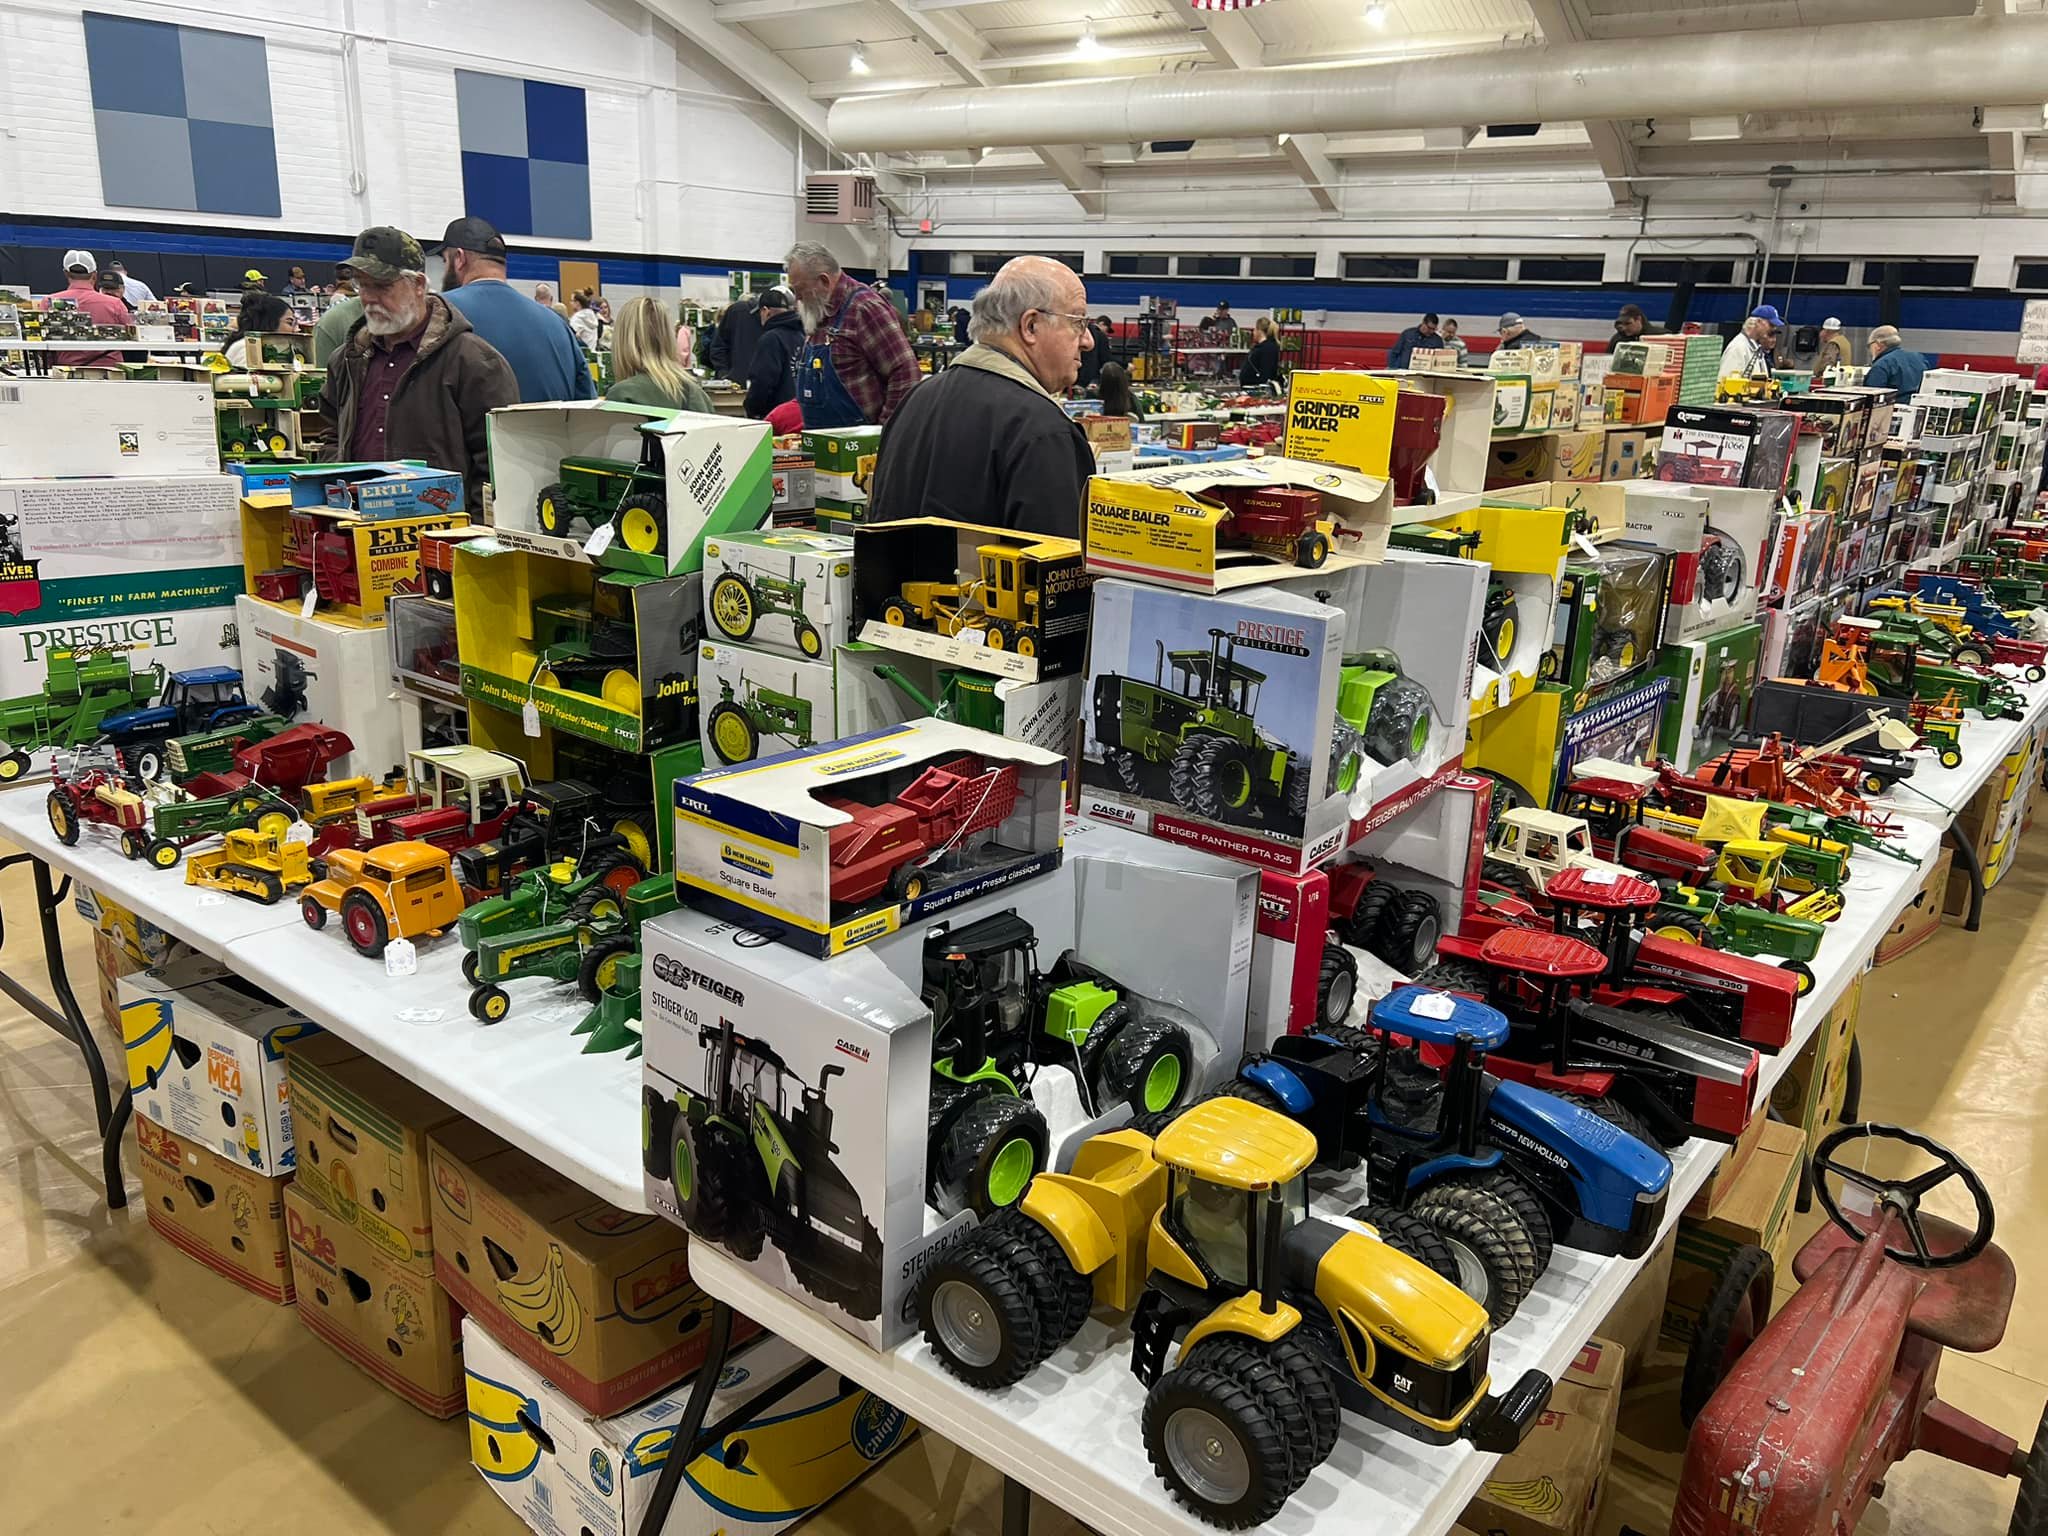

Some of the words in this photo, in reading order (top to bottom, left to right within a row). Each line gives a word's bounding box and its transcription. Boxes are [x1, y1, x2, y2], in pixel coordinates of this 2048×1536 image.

[1311, 388, 1342, 396] HOLLAND
[1294, 400, 1360, 419] GRINDER
[1292, 415, 1338, 432] MIXER
[1697, 432, 1745, 441] INTERNTIONAL
[1724, 441, 1745, 450] 1066
[845, 441, 859, 452] 435
[689, 469, 704, 493] JOHN
[703, 442, 722, 470] DEERE
[705, 455, 722, 481] MFWD
[361, 483, 412, 497] ERTL
[697, 467, 723, 505] TRACTOR
[1256, 499, 1282, 508] HOLLAND
[1090, 503, 1130, 520] SQUARE
[1132, 510, 1170, 527] BALER
[1625, 521, 1653, 531] RACTOR
[497, 533, 512, 541] JOHN
[513, 535, 532, 545] DEERE
[375, 544, 410, 555] MASSEY
[531, 545, 559, 556] TRACTOR
[0, 565, 33, 576] IVER
[371, 557, 409, 572] COMBINE
[815, 563, 824, 578] 2
[1046, 568, 1069, 583] JOHN
[1071, 566, 1087, 579] DEE
[1046, 579, 1075, 594] MOTOR
[111, 594, 123, 602] IN
[128, 592, 156, 600] FARM
[19, 617, 177, 662] PRESTIGE
[1238, 619, 1305, 648] PRESTIGE
[71, 643, 136, 660] Collection
[1236, 639, 1305, 656] COLLECTION
[656, 680, 688, 698] John
[480, 682, 500, 697] John
[501, 689, 526, 705] Deere
[532, 699, 555, 715] 420T
[555, 708, 609, 733] Tractor/Tracteur
[1022, 714, 1038, 737] JOHN
[1037, 692, 1058, 717] DEERE
[681, 796, 711, 813] ERTL
[1092, 803, 1124, 818] CASE
[1365, 806, 1398, 833] STEIGER
[1398, 783, 1434, 810] PANTHER
[1158, 823, 1199, 840] STEIGER
[1201, 834, 1249, 854] PANTHER
[1251, 847, 1271, 859] PTA
[1274, 852, 1293, 865] 325
[1309, 838, 1334, 860] CASE
[732, 849, 745, 860] NEW
[744, 852, 770, 869] HOLLAND
[719, 870, 751, 889] Square
[753, 883, 777, 899] Baler
[923, 895, 952, 912] Square
[954, 886, 975, 900] Baler
[982, 875, 1007, 890] Presse
[1008, 863, 1041, 882] classique
[1259, 898, 1286, 913] RTL
[1308, 891, 1319, 902] 1/16
[853, 926, 865, 937] NEW
[865, 918, 886, 933] HOLLAND
[1650, 965, 1673, 975] CASE
[681, 966, 745, 1007] STEIGER
[1718, 979, 1743, 991] 9390
[652, 991, 682, 1018] STEIGER
[684, 1006, 698, 1026] 620
[837, 1039, 861, 1054] CASE
[1596, 1036, 1638, 1055] CASE
[207, 1047, 240, 1069] DESPICABLE
[135, 1111, 181, 1167] Dole
[1490, 1118, 1518, 1137] TJ375
[1518, 1134, 1535, 1150] NEW
[1534, 1144, 1568, 1169] HOLLAND
[140, 1155, 185, 1192] BANANAS
[438, 1164, 466, 1203] Dole
[288, 1206, 336, 1267] Dole
[902, 1236, 947, 1279] STEIGER
[632, 1262, 688, 1305] Dole
[609, 1361, 657, 1394] PREMIUM
[661, 1341, 705, 1369] BANANA
[1394, 1373, 1413, 1392] CAT
[864, 1406, 900, 1458] Chiqui
